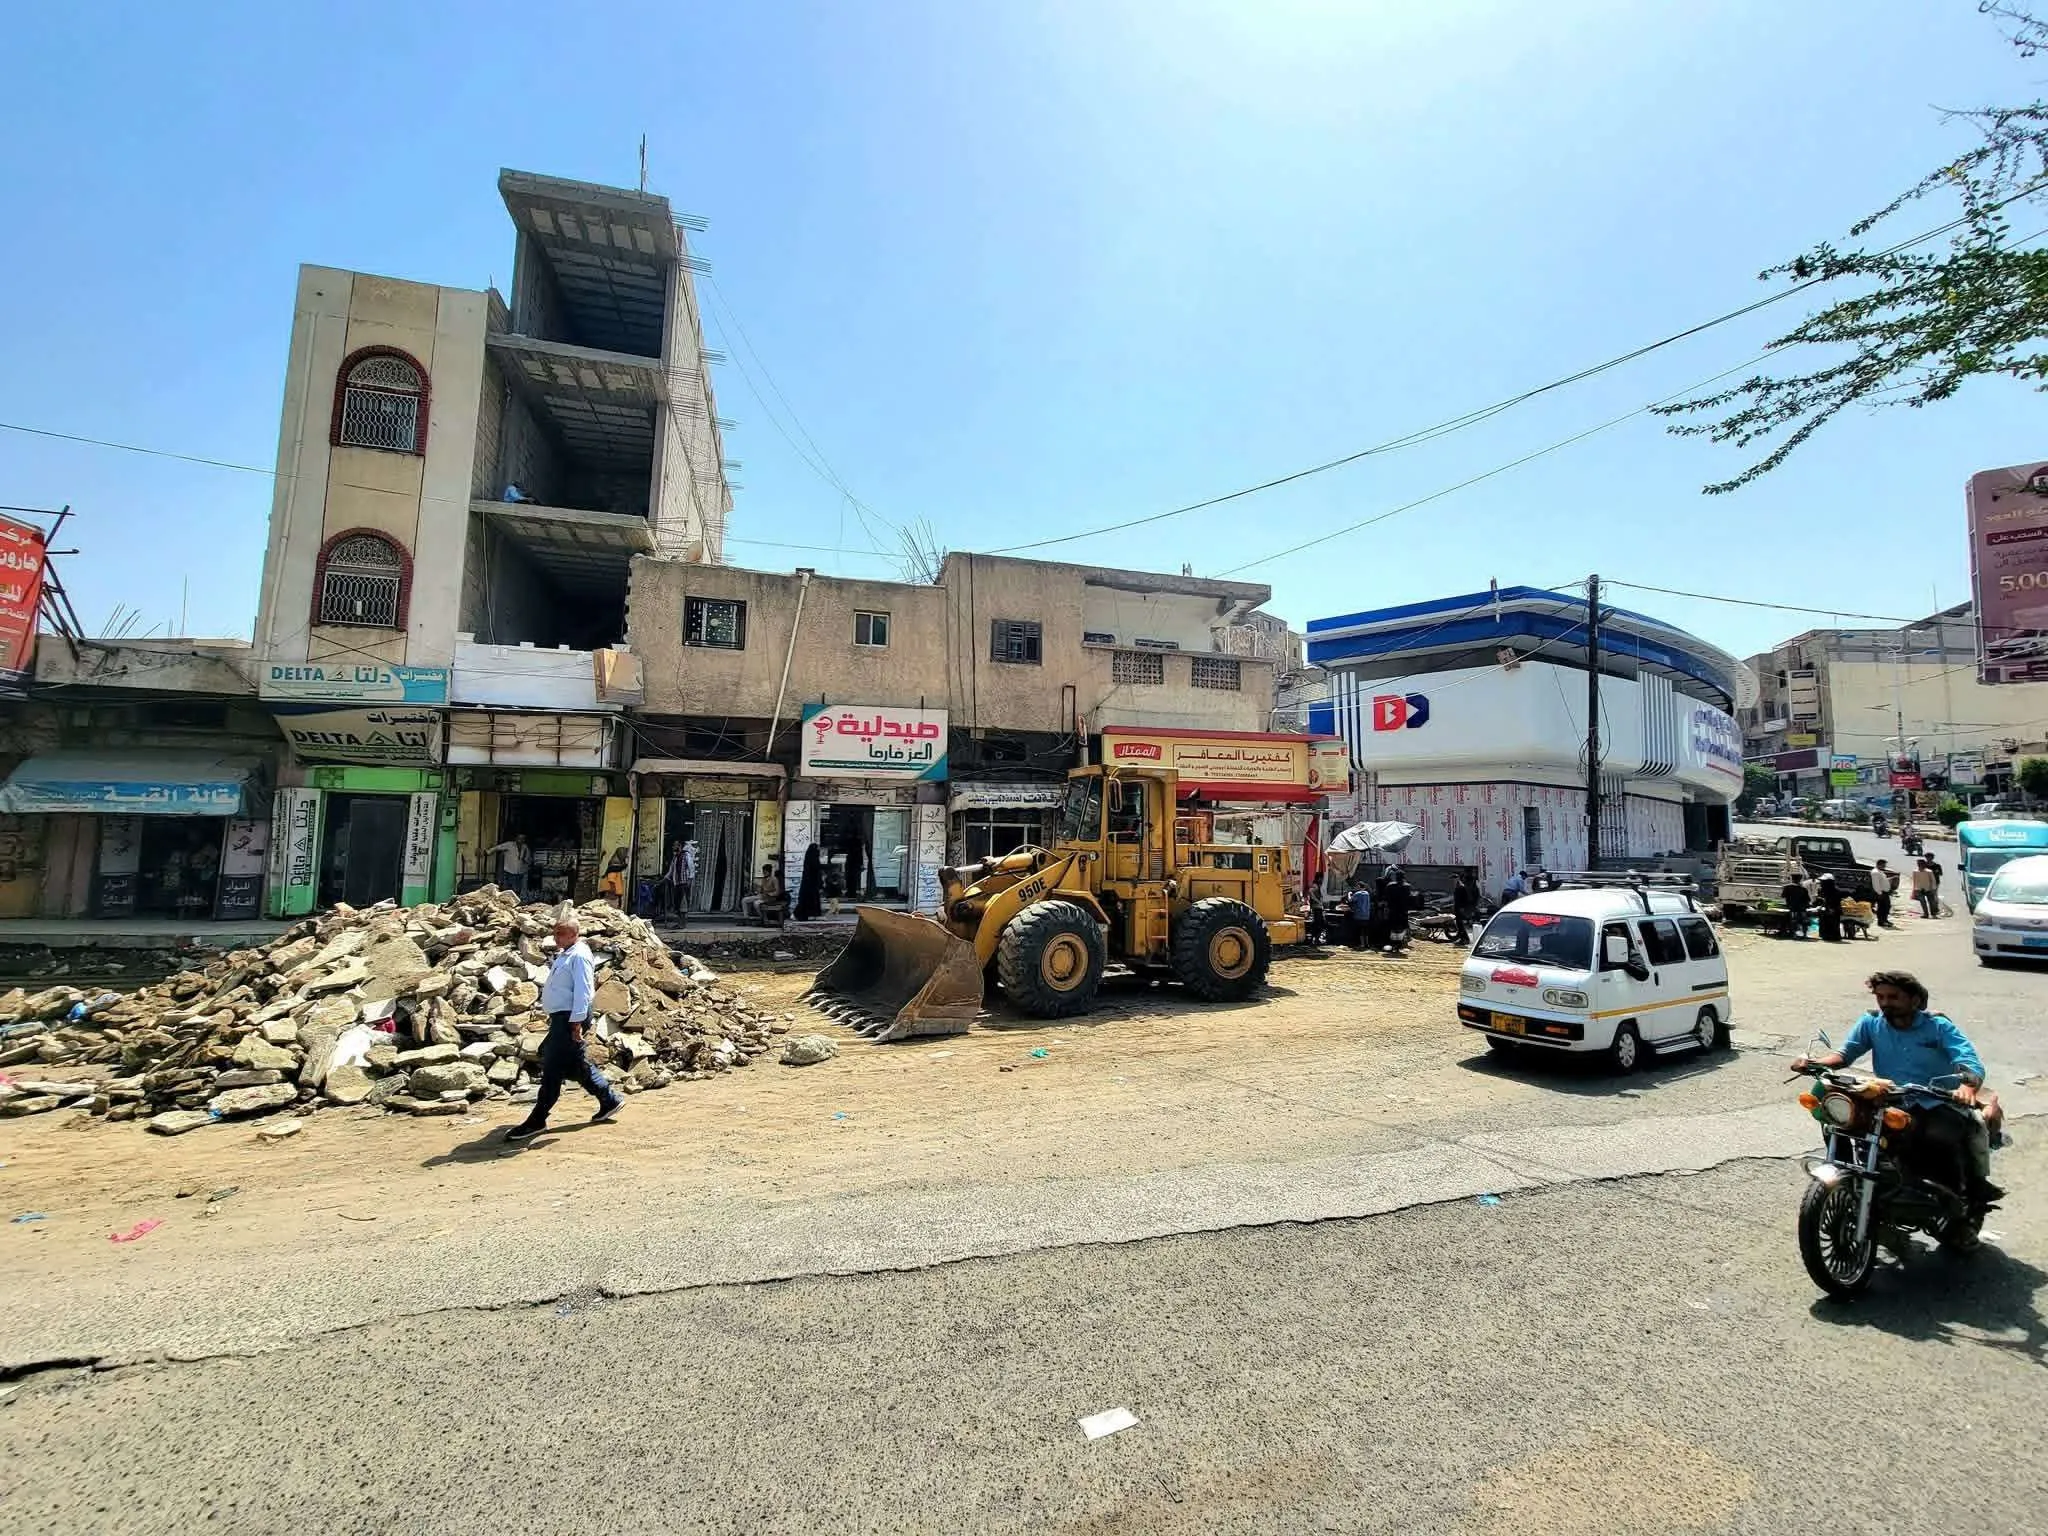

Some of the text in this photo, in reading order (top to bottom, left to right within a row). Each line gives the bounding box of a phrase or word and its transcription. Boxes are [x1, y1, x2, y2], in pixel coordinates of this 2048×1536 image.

[0, 527, 32, 546] مرك
[271, 666, 325, 681] DELTA
[355, 666, 443, 684] مختبرات دلتا
[290, 730, 363, 746] DELTA
[836, 713, 940, 745] صيدلية
[395, 731, 427, 747] لتا
[869, 743, 933, 762] العز فارما
[1118, 745, 1157, 758] الممتاز
[1177, 748, 1290, 764] كفتيريا المعافر
[186, 786, 240, 804] بقالة
[295, 800, 310, 828] دلتا
[290, 855, 306, 887] Delta
[1018, 877, 1047, 902] 950E
